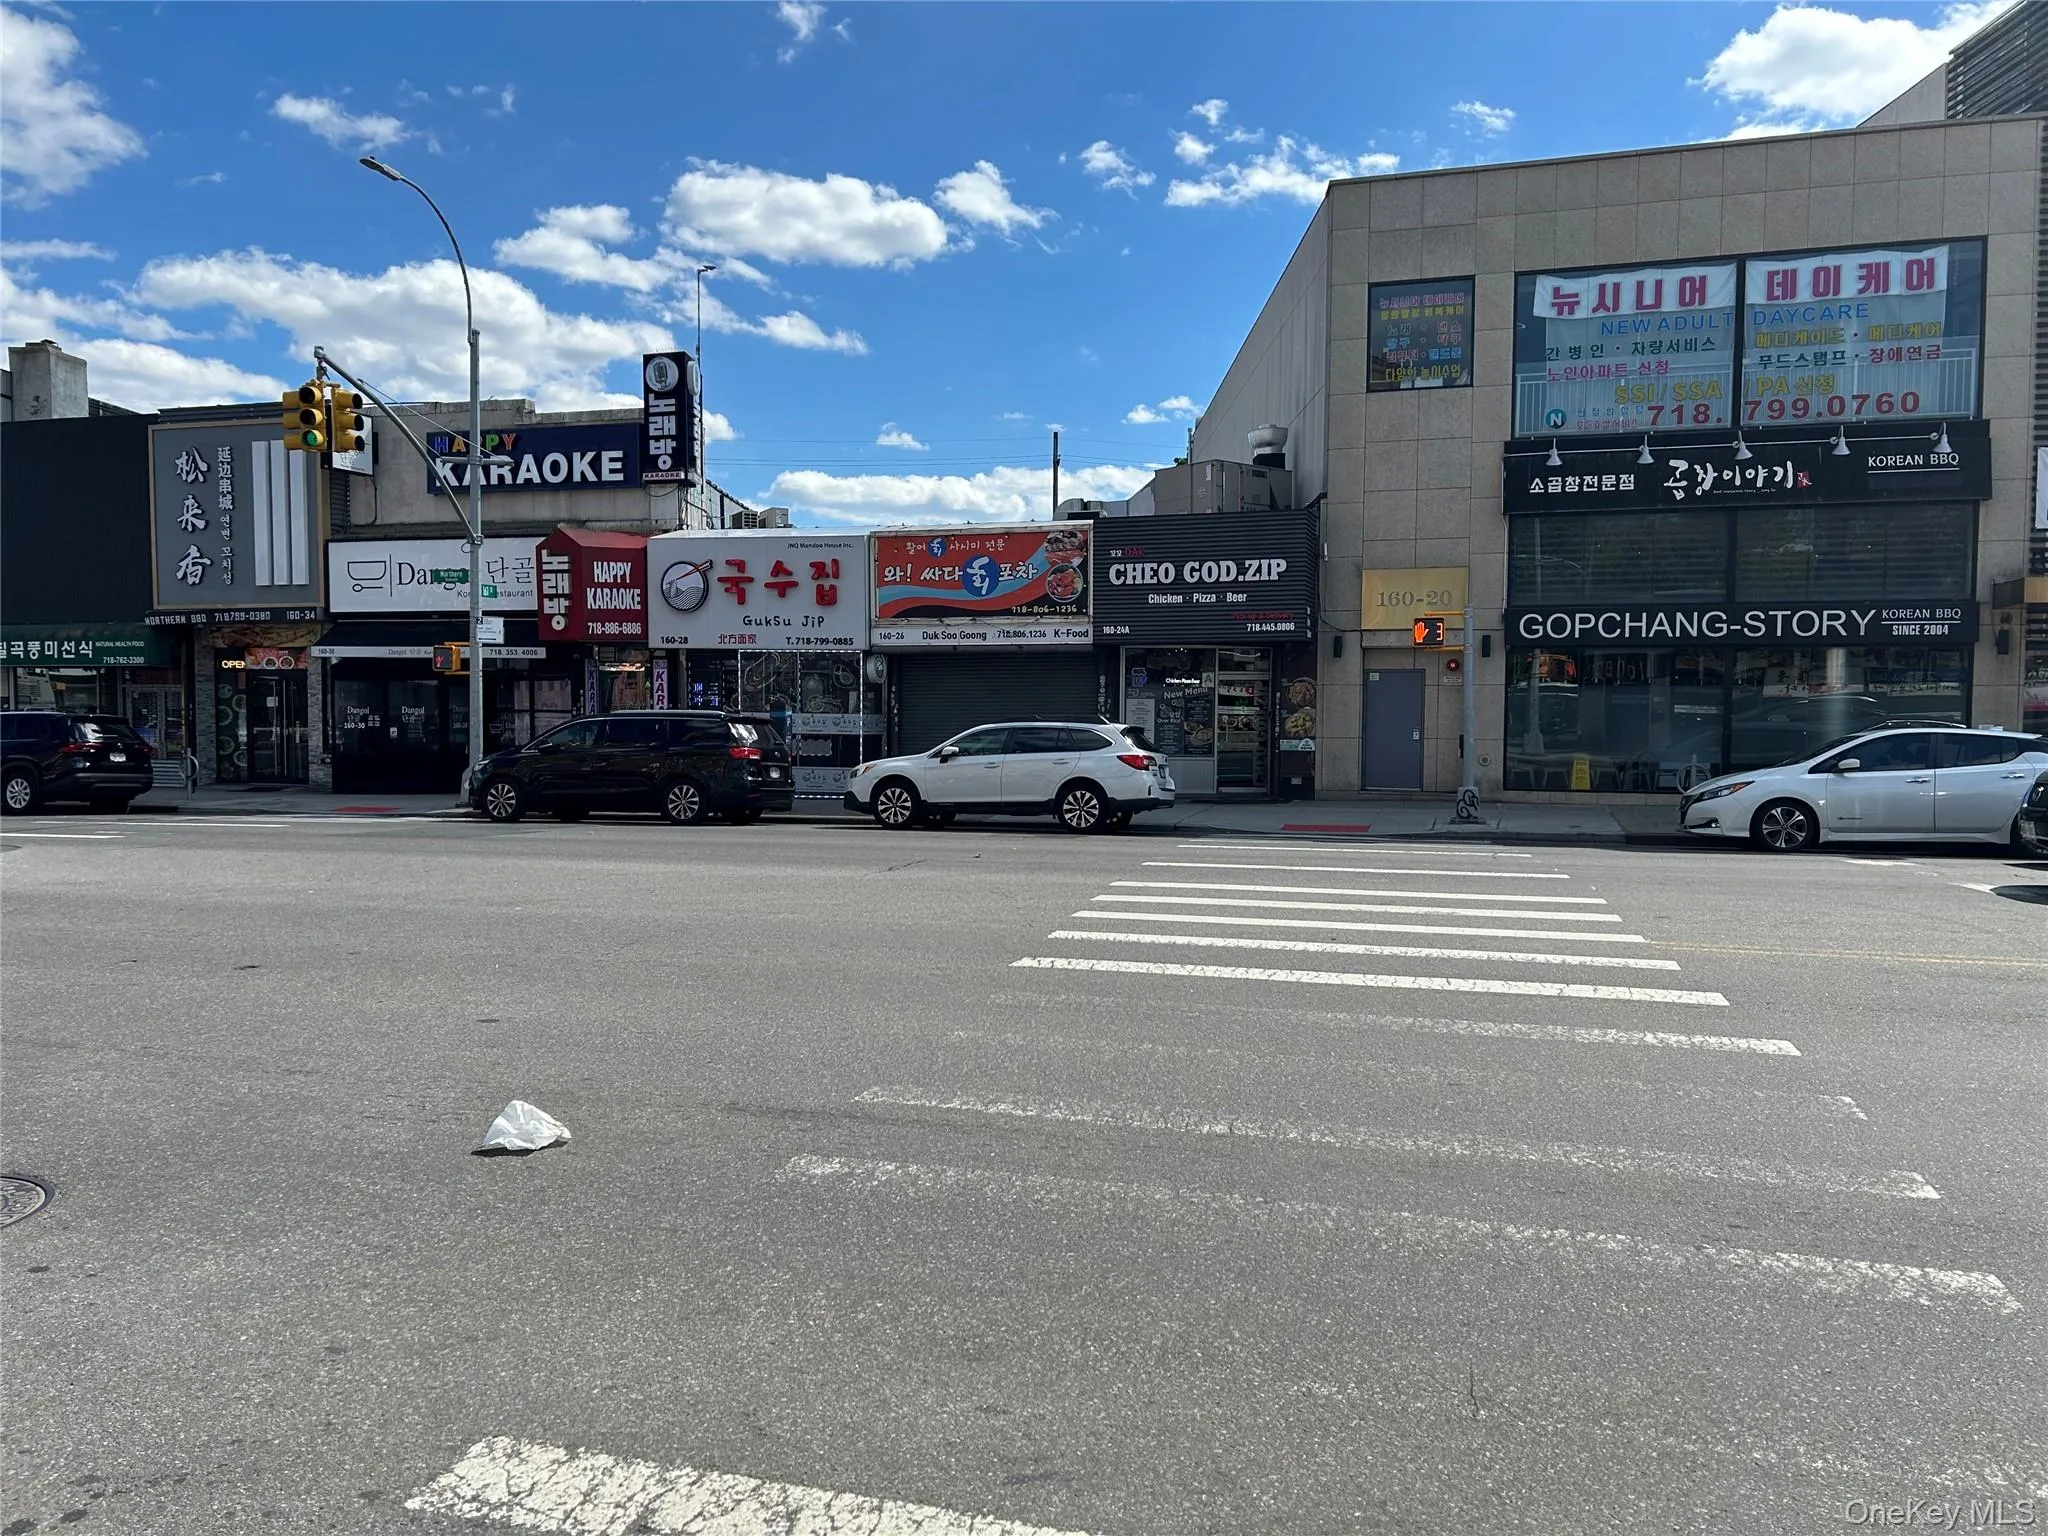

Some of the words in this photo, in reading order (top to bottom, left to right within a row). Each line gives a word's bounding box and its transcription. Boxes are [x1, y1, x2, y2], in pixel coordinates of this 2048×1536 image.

[1551, 275, 1707, 316] 뉴시니어
[1766, 256, 1935, 301] 데이케어
[1601, 319, 1650, 336] NEW
[1657, 312, 1734, 332] ADULT
[1754, 303, 1869, 325] DAYCARE
[1755, 327, 1846, 348] 메디케이드
[1868, 321, 1942, 342] 메디케어
[1632, 336, 1716, 356] 차량서비스
[1758, 350, 1847, 369] 푸드스탬프
[1869, 344, 1942, 363] 장애연금
[1547, 363, 1629, 381] 노인아파트
[1638, 360, 1669, 376] 신청
[1795, 375, 1835, 396] 신청
[1744, 391, 1920, 421] 799.0760
[648, 393, 677, 471] 노래방
[434, 433, 516, 453] HAPY
[1868, 455, 1924, 467] KOREAN
[1930, 453, 1960, 466] BBQ
[217, 446, 234, 510] 延边串城
[1529, 474, 1635, 494] 소곱창전문점
[1663, 459, 1794, 500] 곱창이야기
[949, 541, 980, 550] 사시미
[485, 556, 535, 584] 단골
[594, 561, 632, 583] HAPPY
[883, 563, 912, 583] 와!
[920, 566, 964, 581] 싸다
[998, 561, 1038, 581] 포차
[1109, 562, 1176, 585] CHEO
[1183, 559, 1287, 583] GOD.ZIP
[541, 549, 570, 631] 노래방
[717, 558, 840, 606] 국수집
[587, 588, 641, 609] KARAOKE
[1148, 593, 1183, 604] Chicken
[1193, 592, 1216, 602] Pizza
[1226, 592, 1248, 602] Beer
[1376, 590, 1453, 607] 160-20
[286, 611, 315, 620] 160-34
[1011, 604, 1077, 613] 718-806-1236
[1882, 609, 1931, 619] KOREAN
[1936, 608, 1962, 619] BBQ
[1103, 626, 1130, 634] 160-24A
[1436, 622, 1443, 641] 3
[1519, 609, 1877, 639] GOPCHANG-STORY
[1892, 625, 1921, 636] SINCE
[1923, 624, 1949, 636] 2004
[660, 636, 689, 645] 160-28
[718, 634, 757, 645] 北方面家
[879, 632, 905, 640] 160-26
[922, 631, 940, 640] Duk
[941, 630, 958, 640] Soo
[959, 630, 987, 641] Goong
[1053, 628, 1089, 638] K-Food
[1164, 690, 1184, 700] New
[1185, 687, 1208, 696] Menu
[347, 705, 370, 715] Dangol
[401, 705, 425, 715] Dangol
